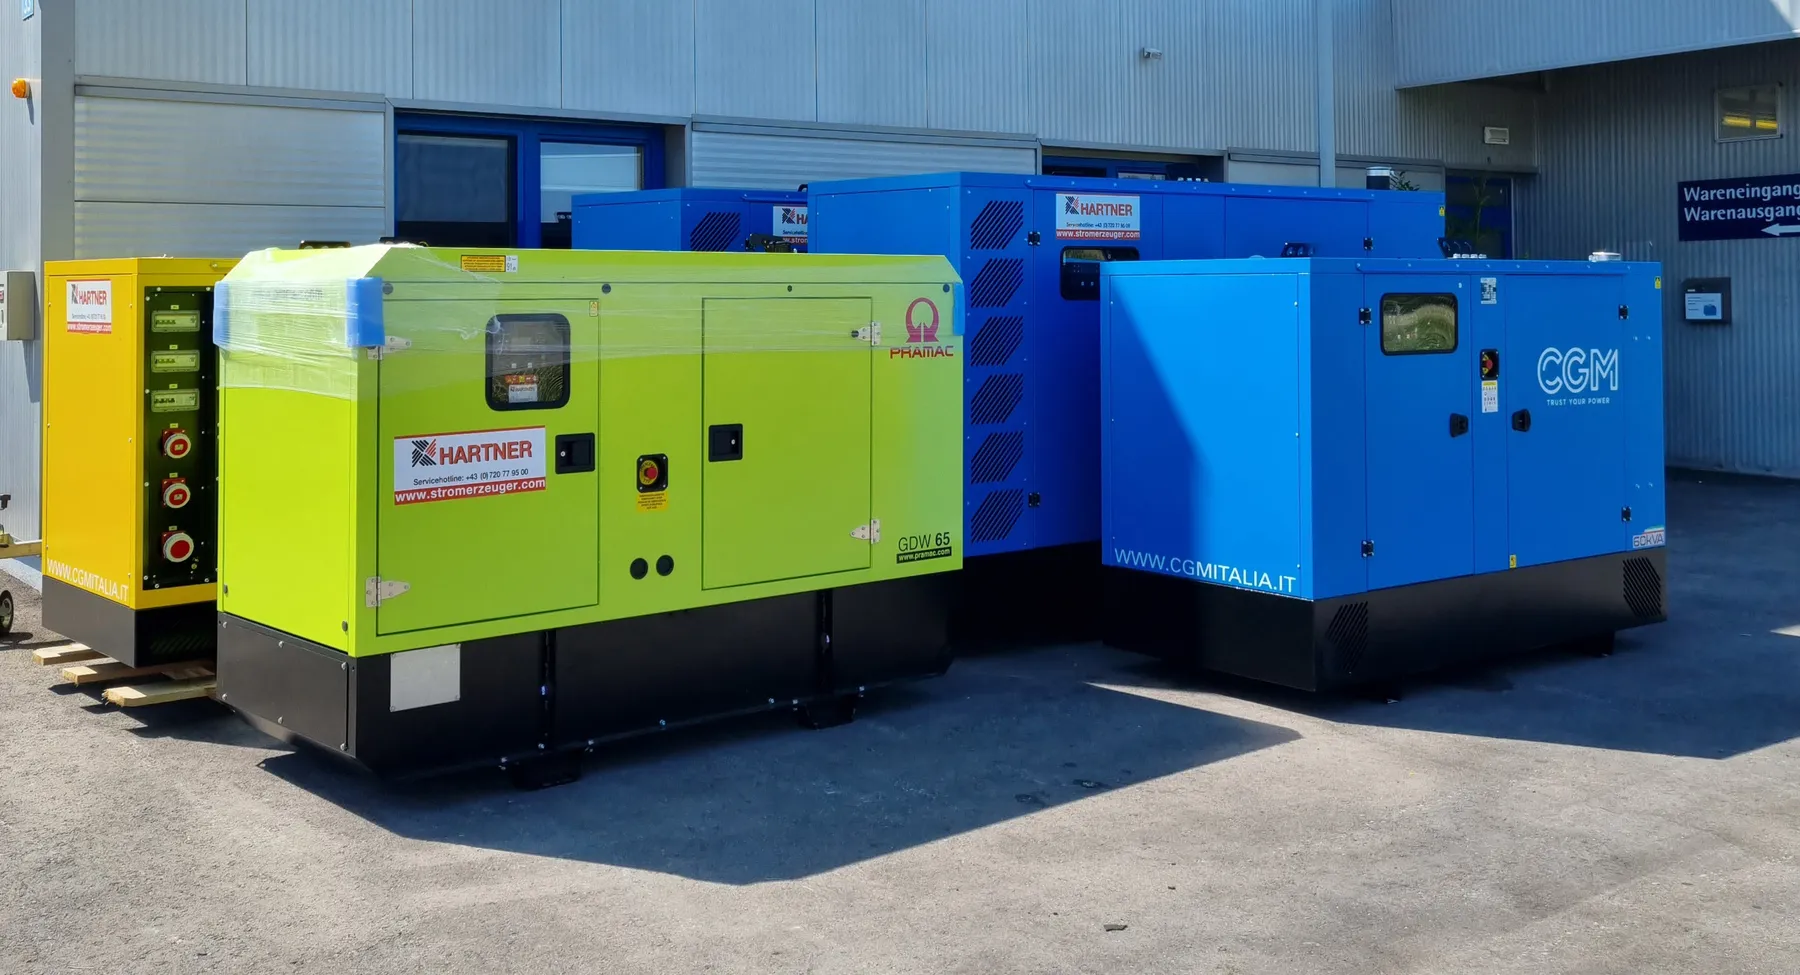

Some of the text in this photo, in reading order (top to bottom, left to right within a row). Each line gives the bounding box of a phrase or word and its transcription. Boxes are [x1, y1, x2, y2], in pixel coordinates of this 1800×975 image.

[1081, 203, 1132, 216] HARTNER
[1056, 230, 1140, 239] www.stromerzeuger.com
[79, 290, 107, 305] HARTNER
[889, 345, 954, 359] PRAMAC
[1537, 347, 1618, 395] CGM
[439, 440, 533, 465] HARTNER
[413, 475, 464, 486] Servicehotline:
[466, 473, 478, 481] +43
[511, 469, 520, 477] 95
[520, 468, 529, 476] 00
[395, 478, 546, 502] www.stromerzeuger.com
[898, 531, 950, 552] GDW 65
[898, 548, 951, 561] www.pramac.com
[1114, 548, 1296, 592] WWW.CGMITALIA.IT
[47, 558, 129, 602] WWW.CGMITALIA.IT
